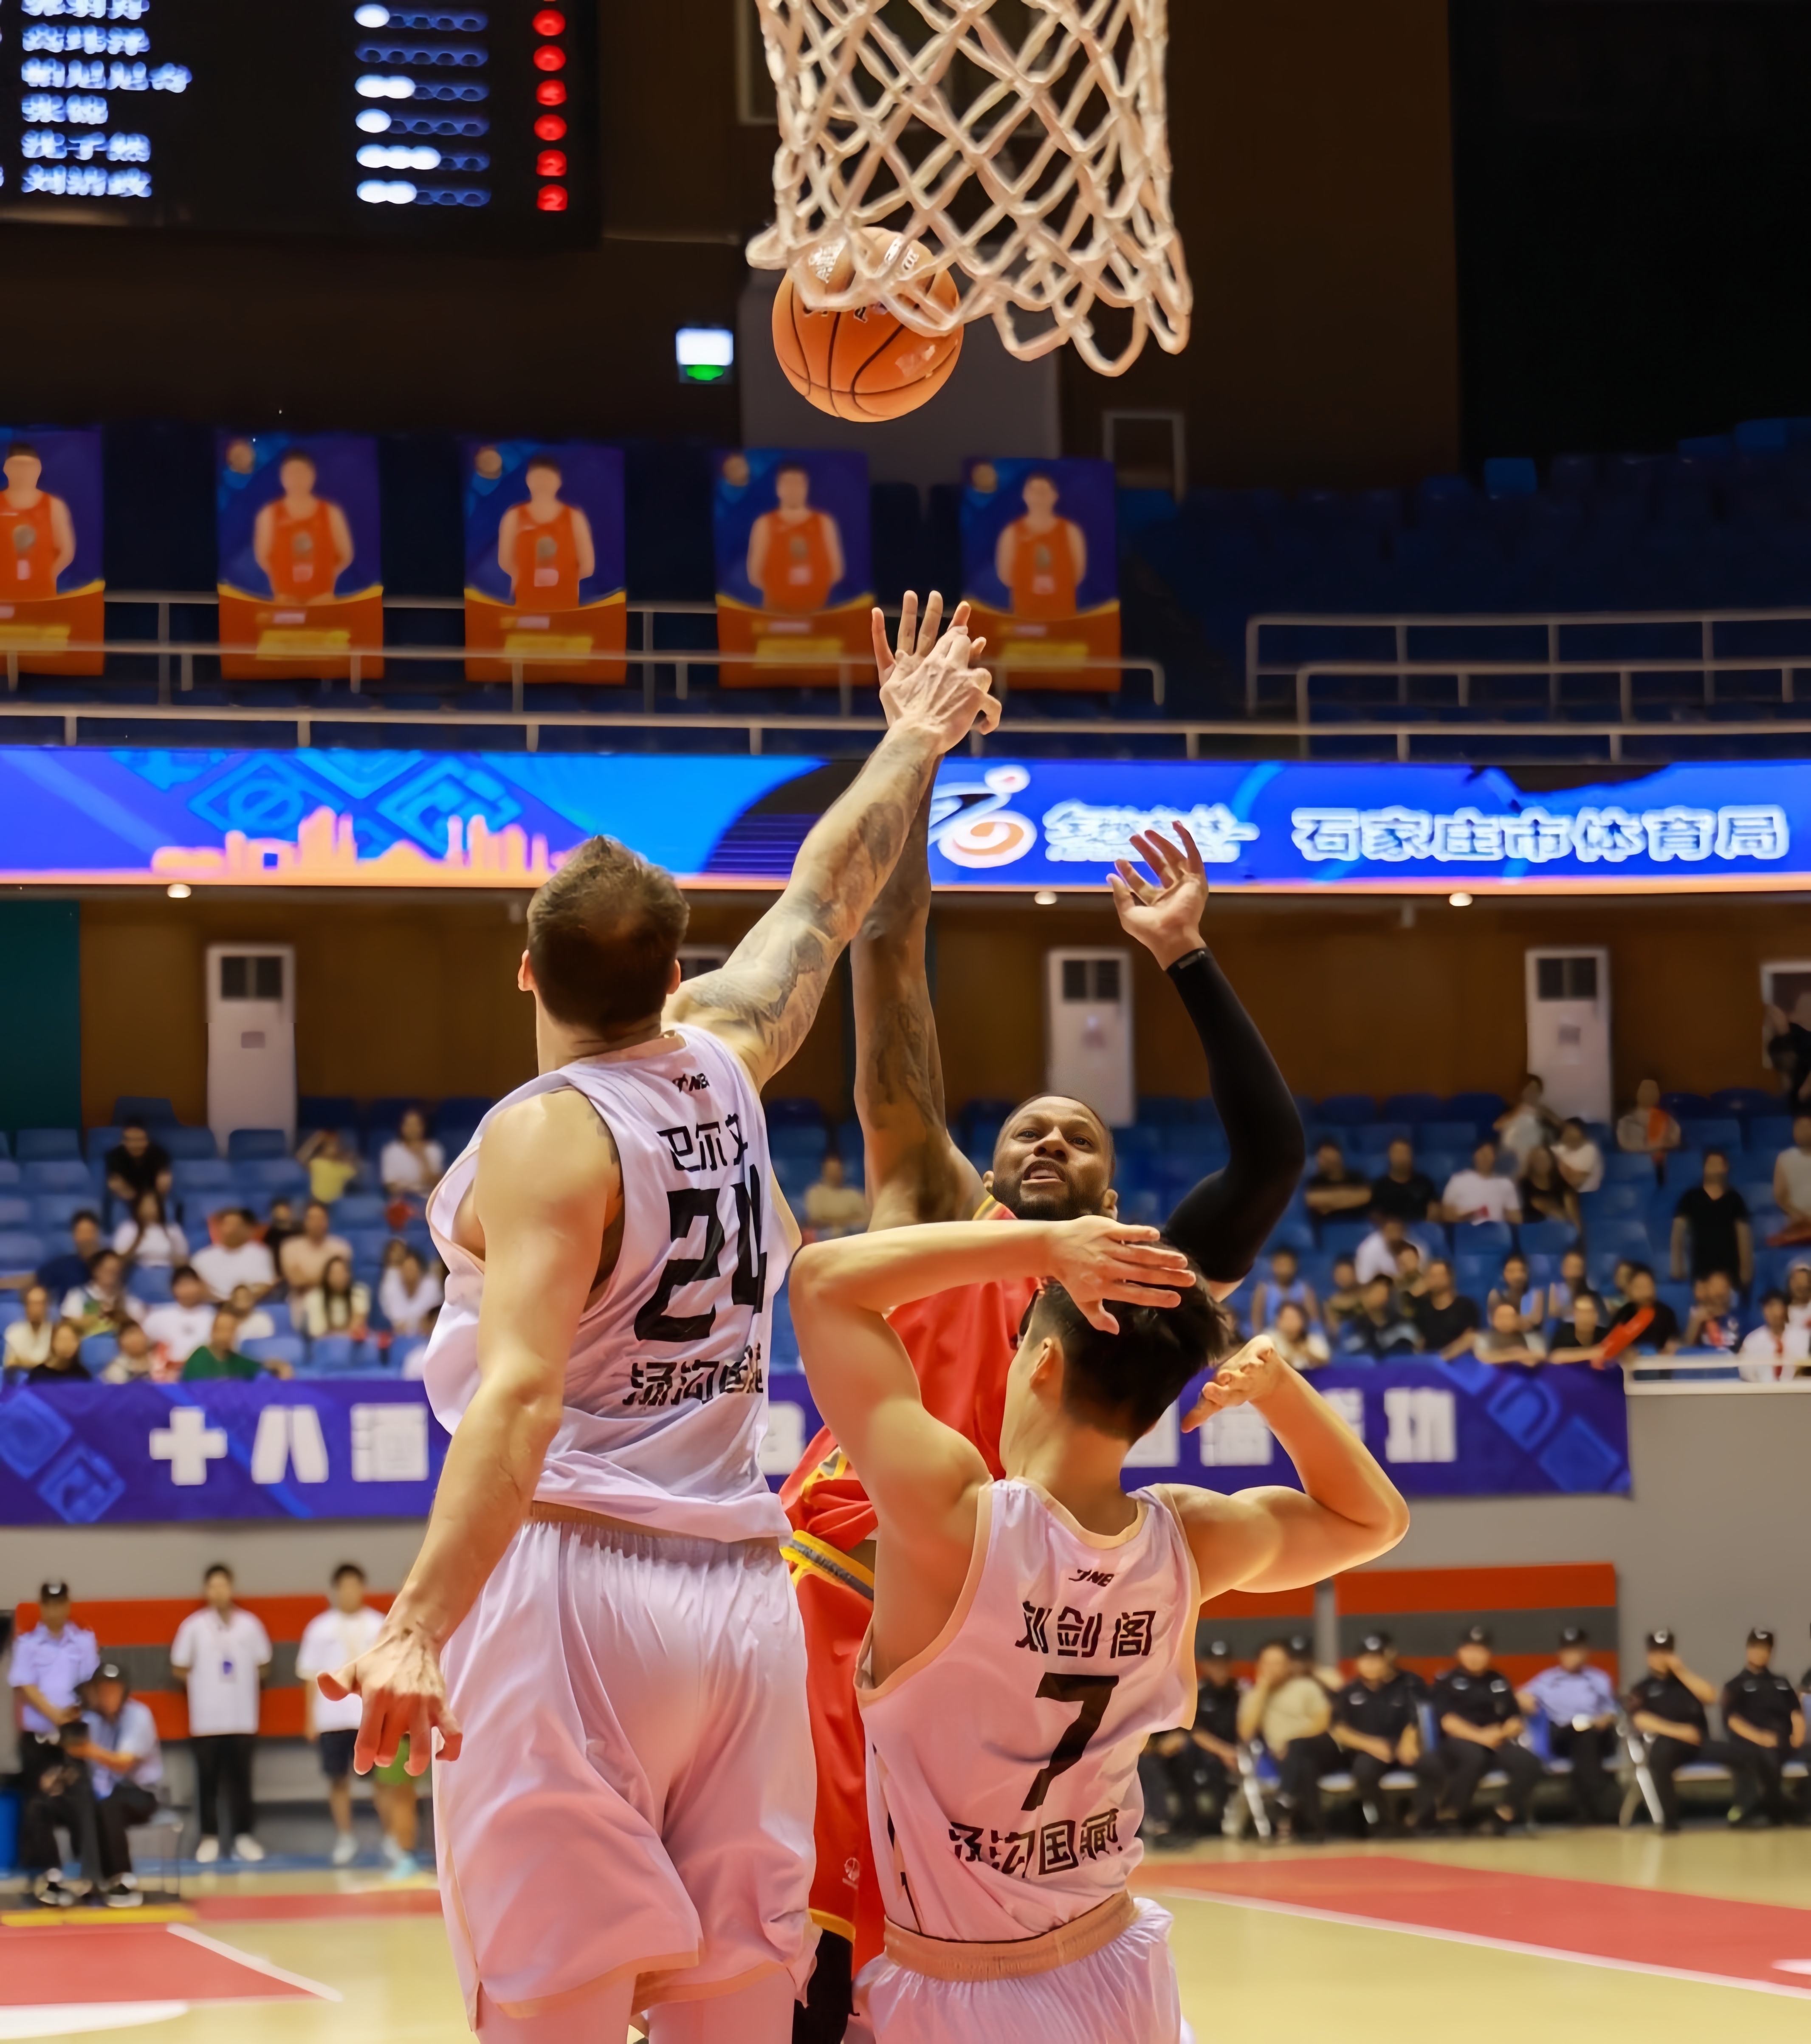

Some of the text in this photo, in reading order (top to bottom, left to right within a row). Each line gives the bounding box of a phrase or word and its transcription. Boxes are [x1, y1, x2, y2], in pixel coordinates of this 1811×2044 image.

[1292, 805, 1788, 862] 石家庄市体育局
[1015, 1601, 1156, 1659] 刘剑阁
[1021, 1672, 1119, 1810] 7
